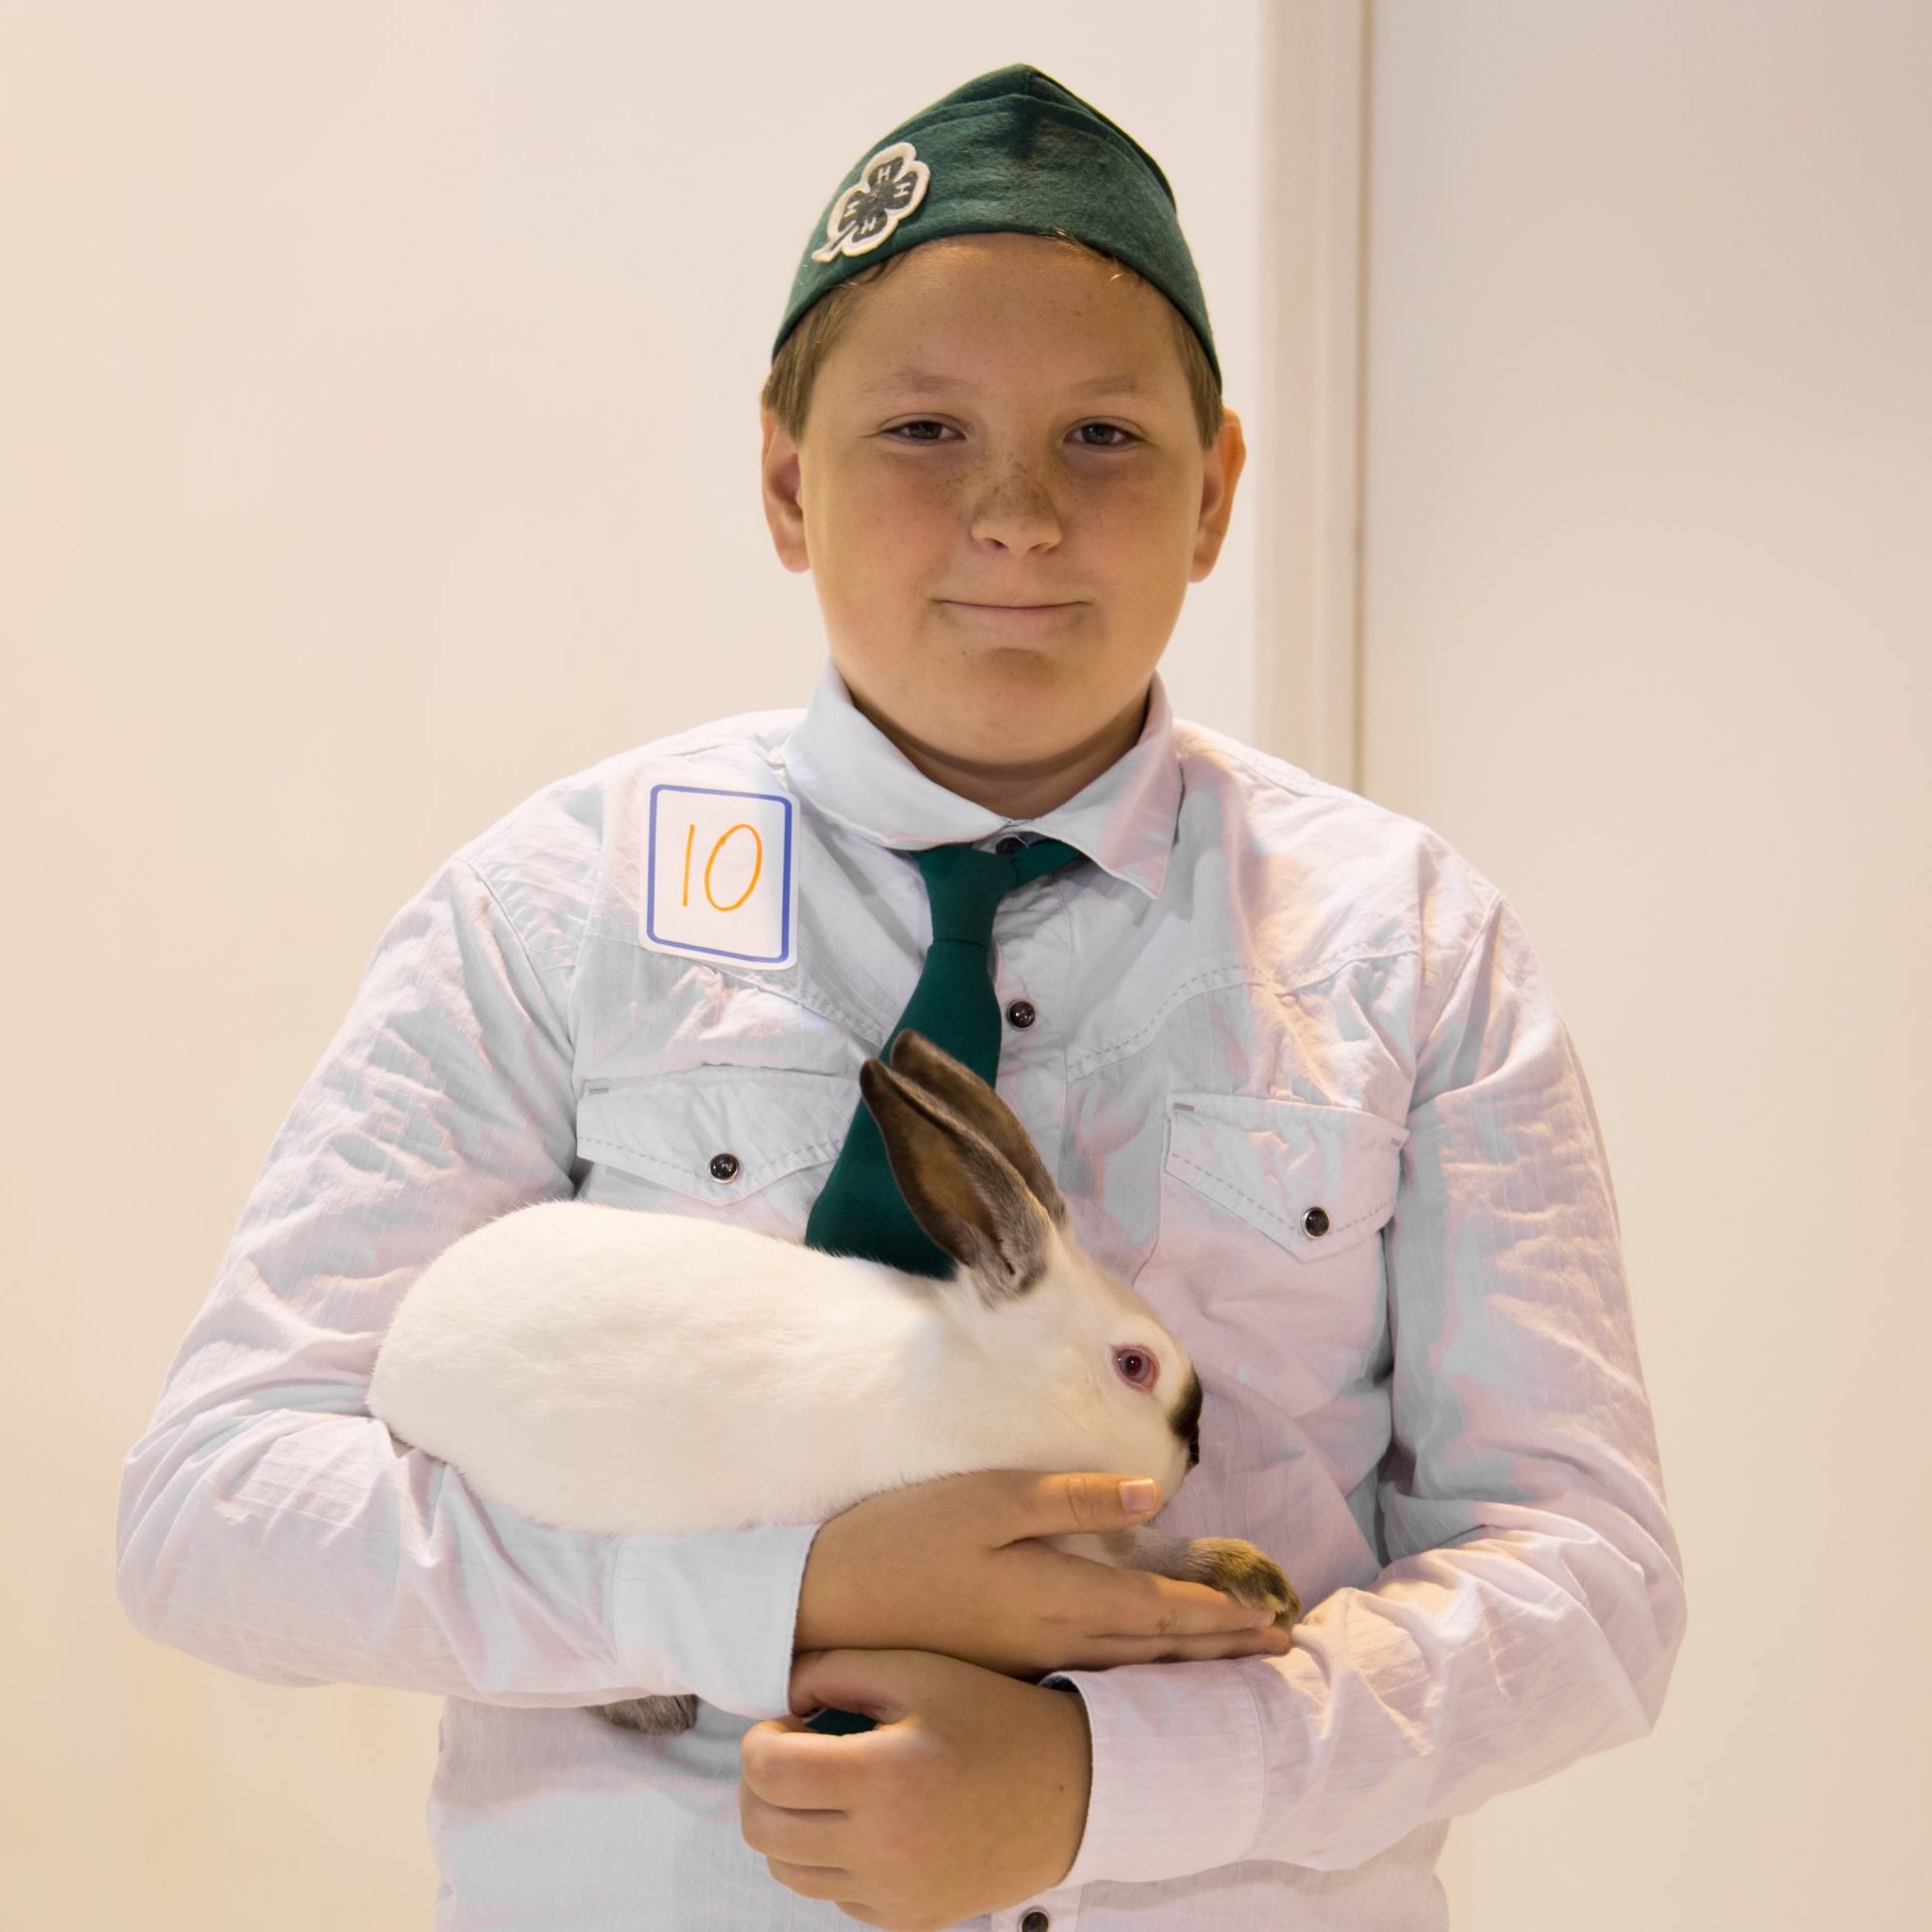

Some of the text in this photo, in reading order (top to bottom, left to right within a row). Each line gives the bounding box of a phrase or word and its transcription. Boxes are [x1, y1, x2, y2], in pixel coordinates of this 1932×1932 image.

[877, 165, 891, 184] H
[893, 182, 912, 198] H
[860, 217, 876, 234] H
[681, 823, 763, 912] 10
